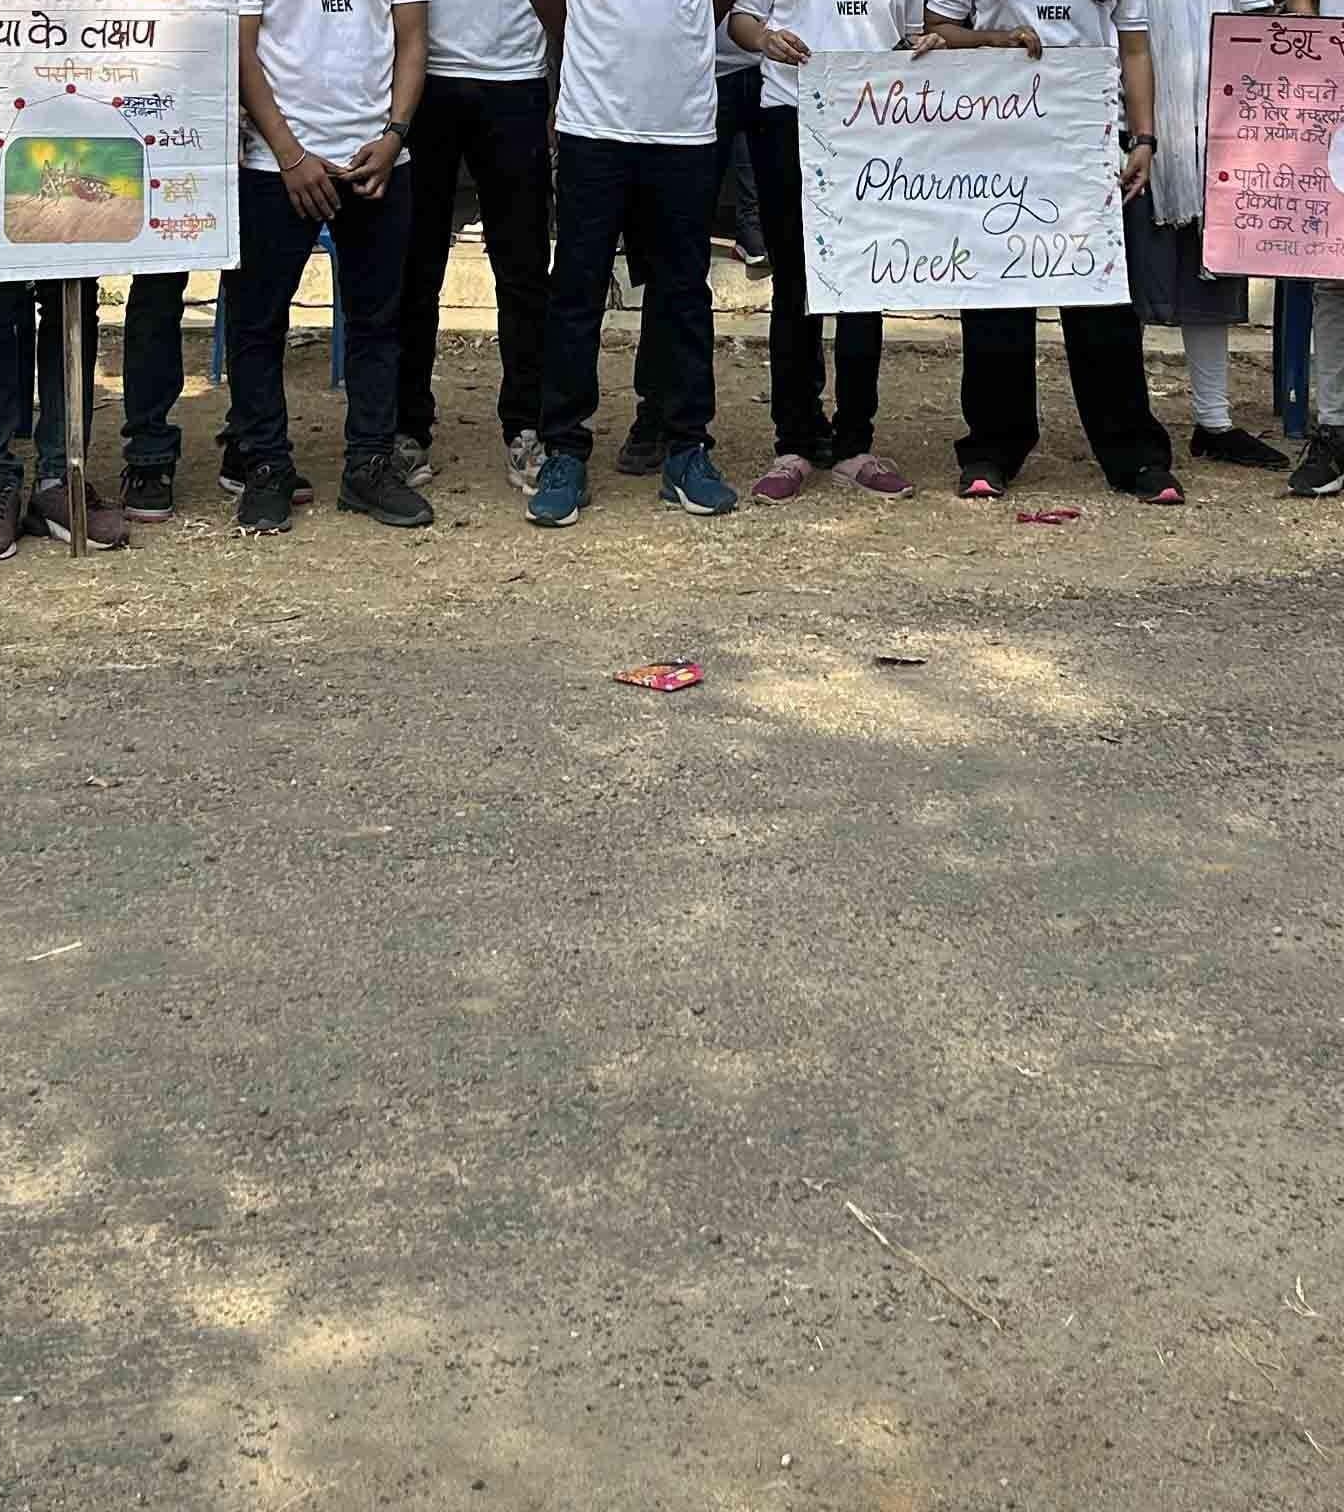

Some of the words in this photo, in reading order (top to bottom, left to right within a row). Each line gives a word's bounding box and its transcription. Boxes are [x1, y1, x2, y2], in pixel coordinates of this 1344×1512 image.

[836, 0, 869, 17] WEEK
[1037, 4, 1071, 20] WEEK
[28, 11, 67, 49] के
[81, 19, 160, 50] लक्षण
[843, 73, 1047, 128] National
[1277, 76, 1291, 100] से
[1293, 78, 1339, 104] बचने
[1238, 99, 1258, 121] के
[1237, 125, 1260, 142] का
[1233, 162, 1270, 189] पानी
[1273, 163, 1296, 191] की
[856, 156, 1059, 236] Pharmacy
[1286, 197, 1302, 213] व
[1268, 215, 1296, 233] कर
[861, 236, 978, 285] Week
[1000, 232, 1096, 280] 2023
